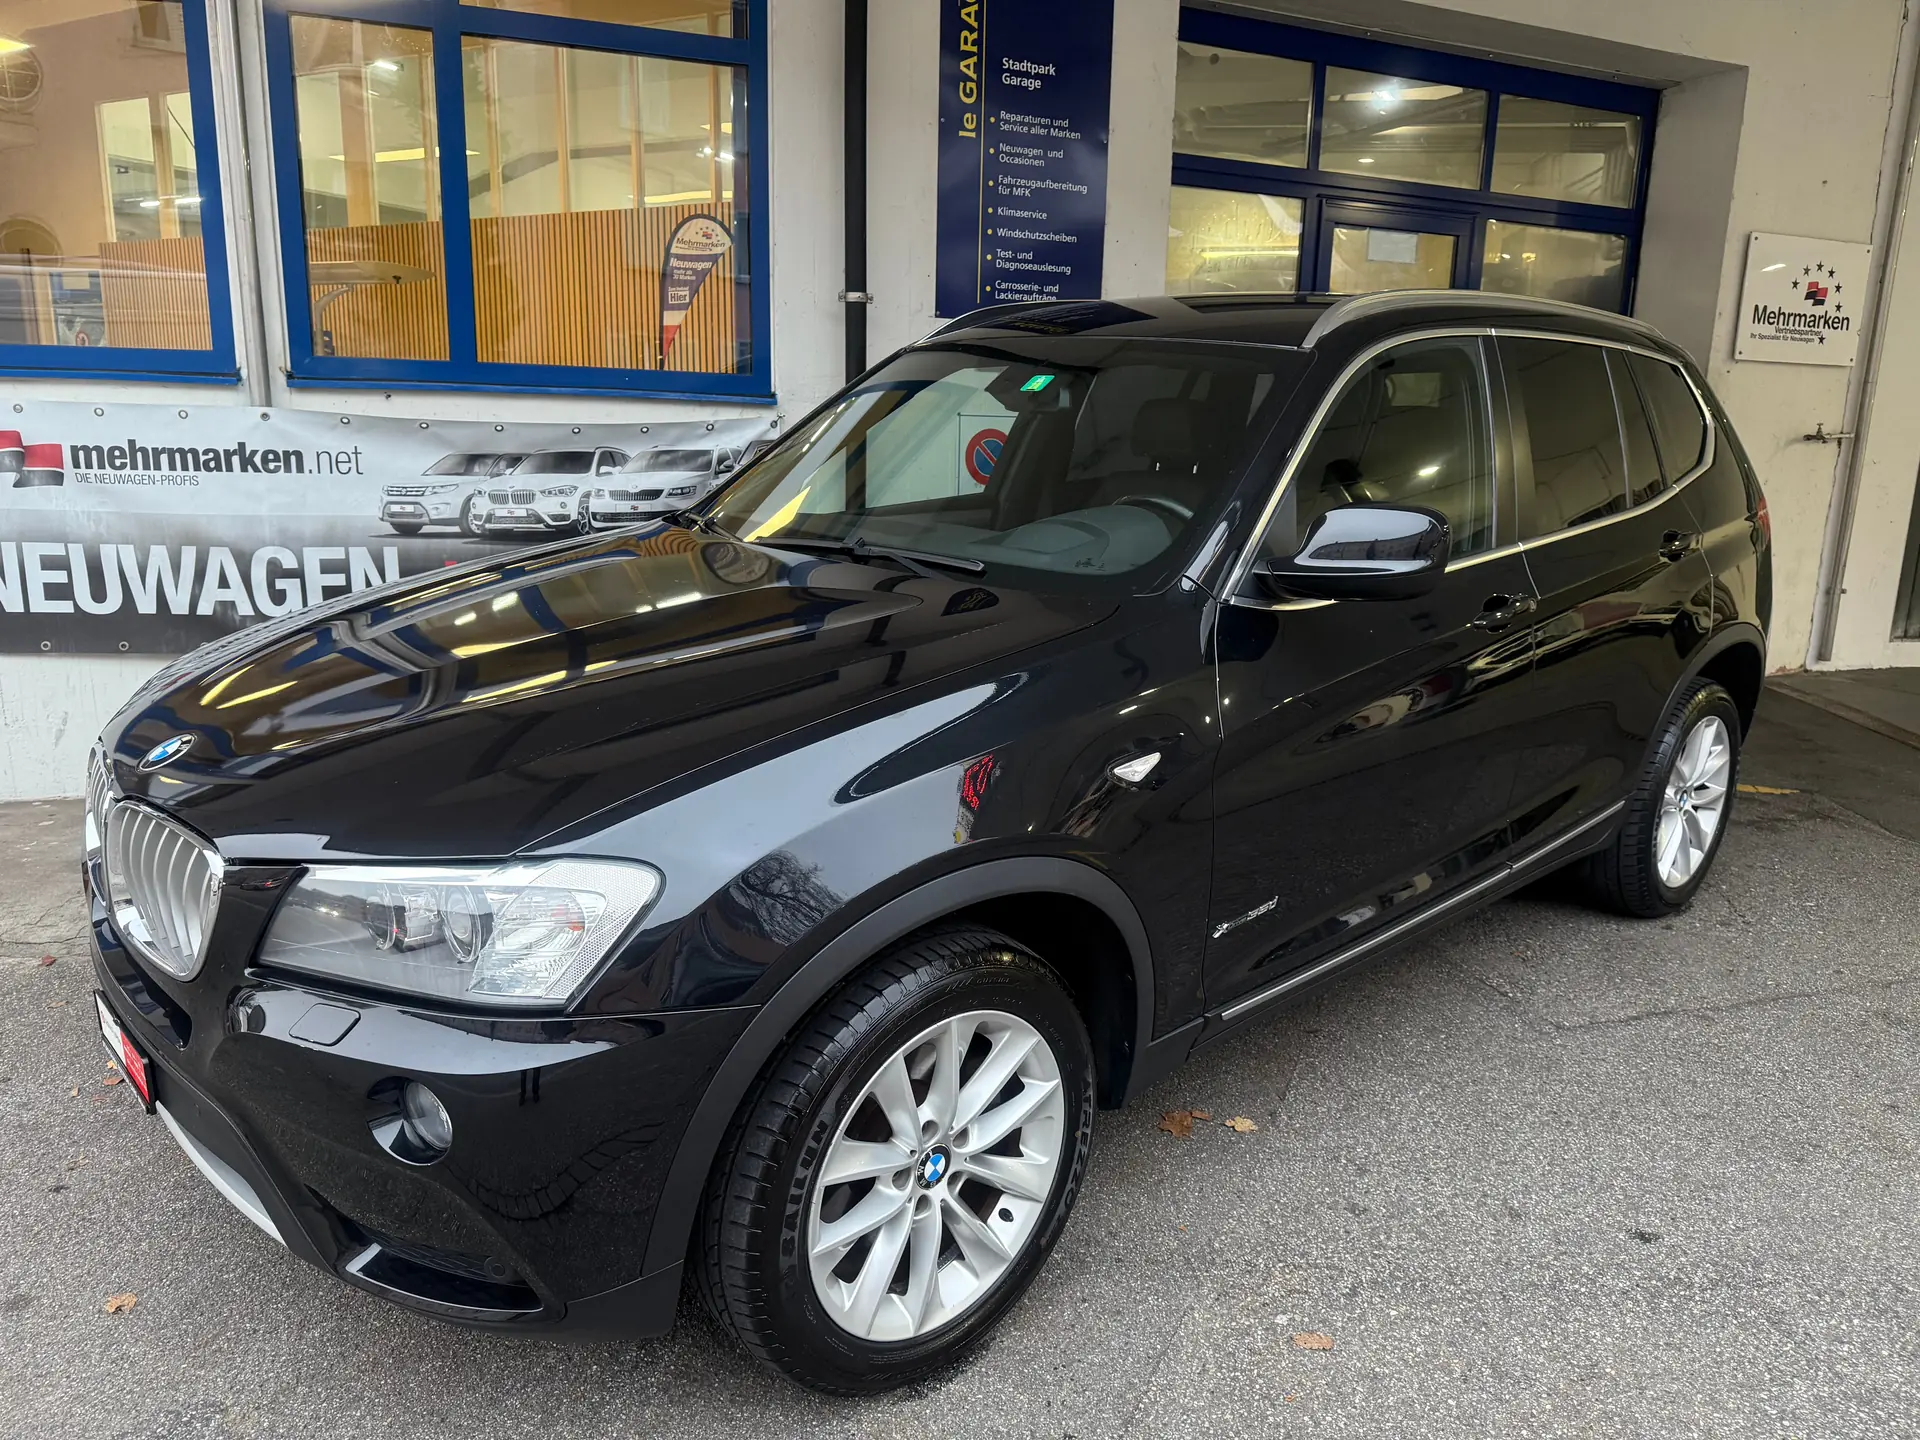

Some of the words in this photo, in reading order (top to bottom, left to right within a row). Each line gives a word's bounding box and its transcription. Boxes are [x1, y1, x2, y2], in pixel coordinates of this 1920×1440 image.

[959, 0, 979, 104] GARA
[1002, 57, 1056, 76] Stadtpark
[1001, 73, 1042, 91] Garage
[958, 112, 977, 138] le
[1000, 110, 1051, 125] Reparaturen
[1052, 118, 1069, 128] und
[999, 121, 1029, 134] Service
[1030, 124, 1048, 136] aller
[1050, 127, 1081, 140] Marken
[999, 142, 1043, 157] Neuwagen
[1047, 149, 1064, 159] und
[999, 153, 1045, 167] Occasionen
[998, 174, 1088, 195] Fahrzeugaufbereitung
[998, 185, 1011, 195] für
[1012, 186, 1031, 198] MFK
[997, 206, 1048, 220] Klimaservice
[676, 237, 726, 248] Mehrmarken
[996, 227, 1077, 243] Windschutzscheiben
[996, 248, 1015, 259] Test-
[1016, 250, 1033, 260] und
[670, 257, 712, 270] Neuwagen
[996, 260, 1071, 275] Diagnoseauslesung
[995, 279, 1042, 292] Carrosserie-
[1043, 283, 1060, 293] und
[670, 292, 688, 302] Hier
[1752, 303, 1850, 331] Mehrmarken
[1774, 326, 1823, 337] Vertriebspartner
[70, 438, 364, 476] mehrmarken.net
[74, 472, 93, 484] DIE
[94, 473, 200, 487] NEUWAGEN-PROFIS
